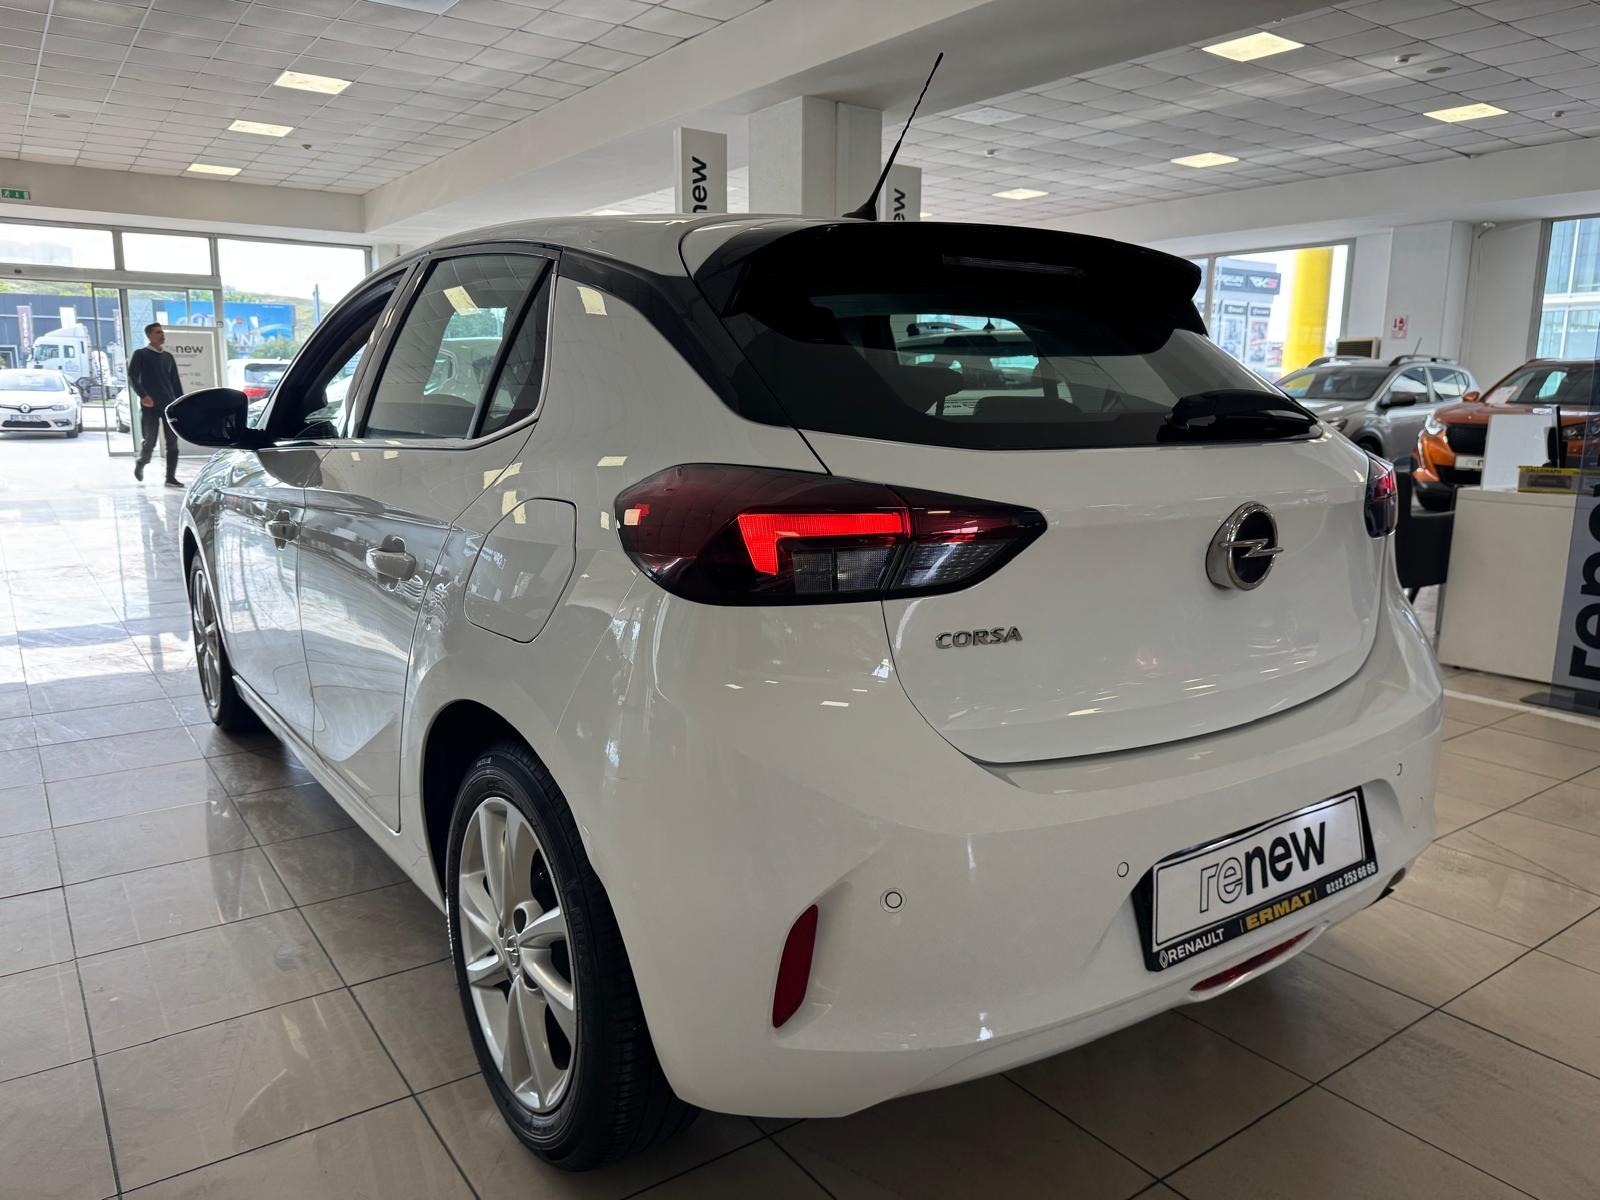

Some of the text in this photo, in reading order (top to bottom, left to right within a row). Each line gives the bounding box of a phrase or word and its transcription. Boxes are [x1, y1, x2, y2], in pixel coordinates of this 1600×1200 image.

[935, 626, 1023, 649] CORSA
[1199, 821, 1326, 913] renew
[1167, 928, 1225, 964] RENAULT
[1246, 889, 1314, 930] ERMAT
[1325, 877, 1344, 894] 0232
[1343, 869, 1358, 886] 253
